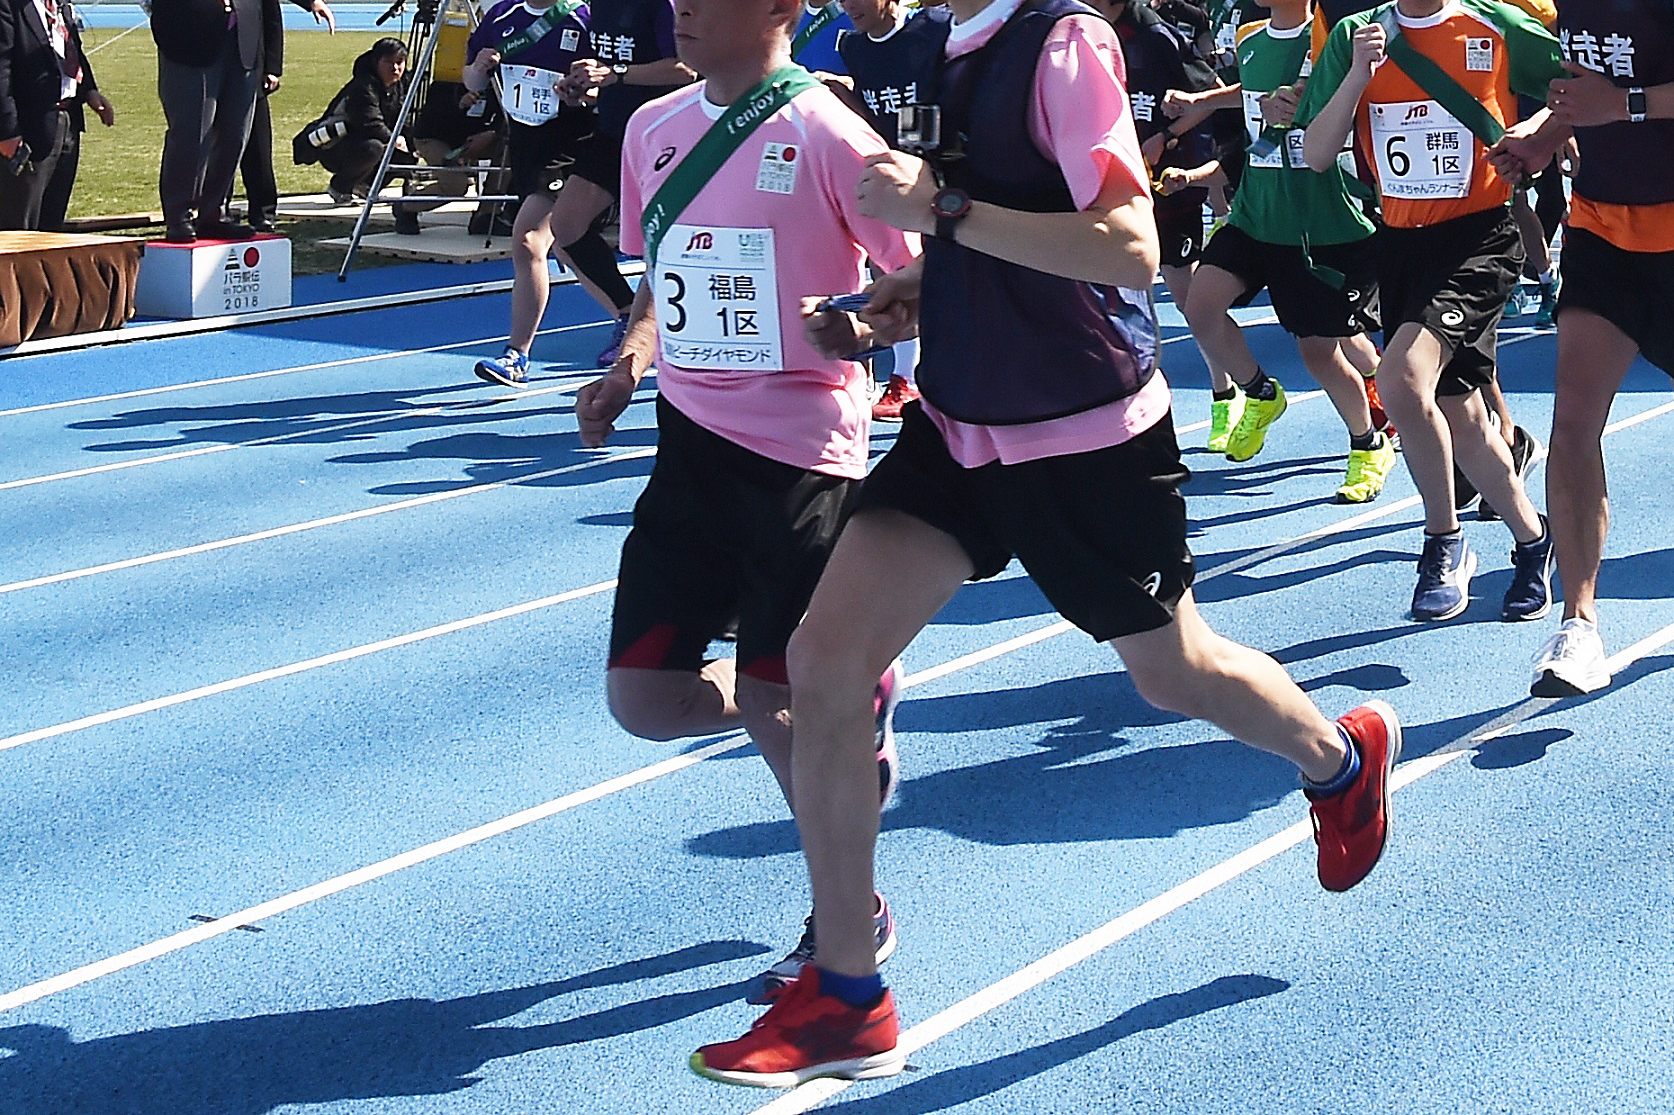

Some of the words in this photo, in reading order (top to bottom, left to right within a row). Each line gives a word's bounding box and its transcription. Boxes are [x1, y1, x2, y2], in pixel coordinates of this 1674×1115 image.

[513, 83, 523, 109] 1
[531, 86, 552, 100] 岩手
[533, 100, 551, 115] 1区
[1404, 105, 1429, 121] JTB
[1425, 131, 1460, 151] 群馬
[1386, 135, 1411, 177] 6
[1431, 154, 1461, 176] 1区
[686, 232, 713, 252] JTB
[224, 270, 260, 285] パラ駅伝
[708, 273, 757, 301] 福島
[232, 283, 260, 294] TOKYO
[225, 296, 258, 310] 2018
[664, 272, 687, 333] 3
[716, 306, 760, 337] 1区
